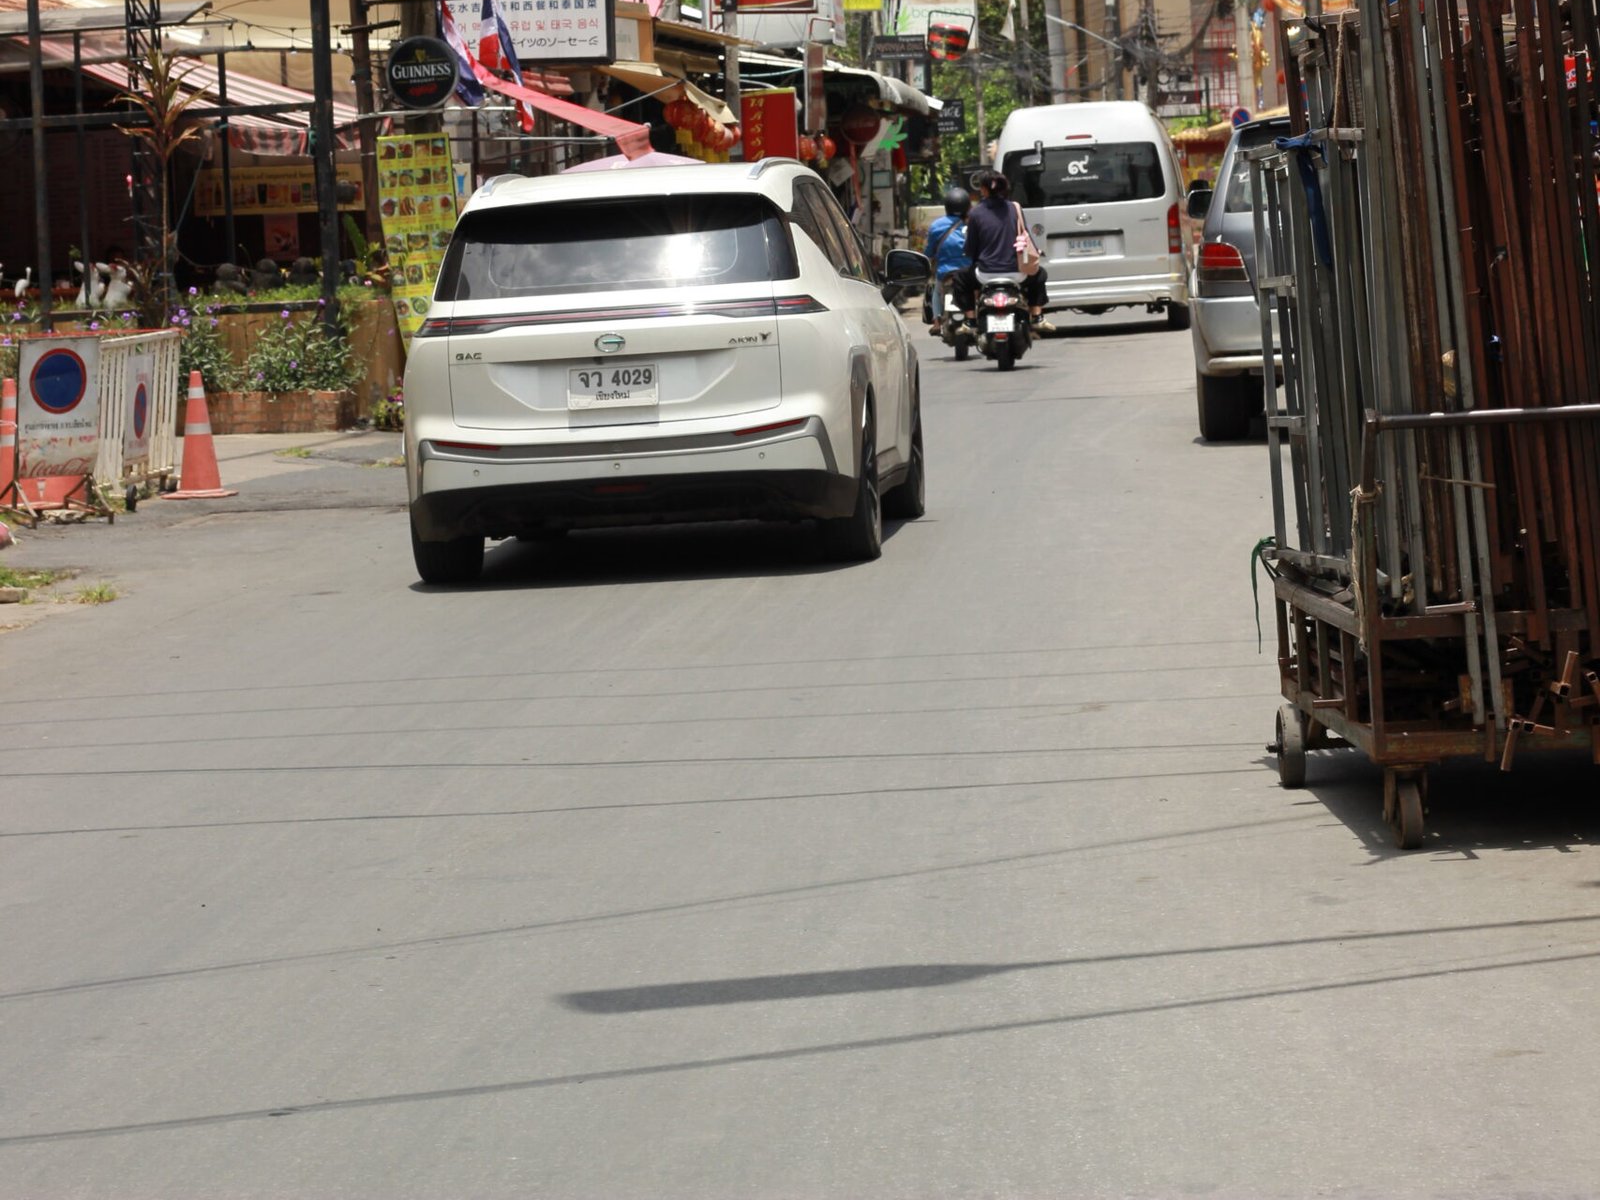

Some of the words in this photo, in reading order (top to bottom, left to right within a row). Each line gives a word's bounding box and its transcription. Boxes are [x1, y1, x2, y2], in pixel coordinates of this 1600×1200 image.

[391, 62, 452, 80] GUINNESS
[455, 352, 482, 361] GAC
[578, 371, 603, 388] จว
[611, 367, 653, 387] 4029
[595, 389, 631, 401] เชียงใหม่
